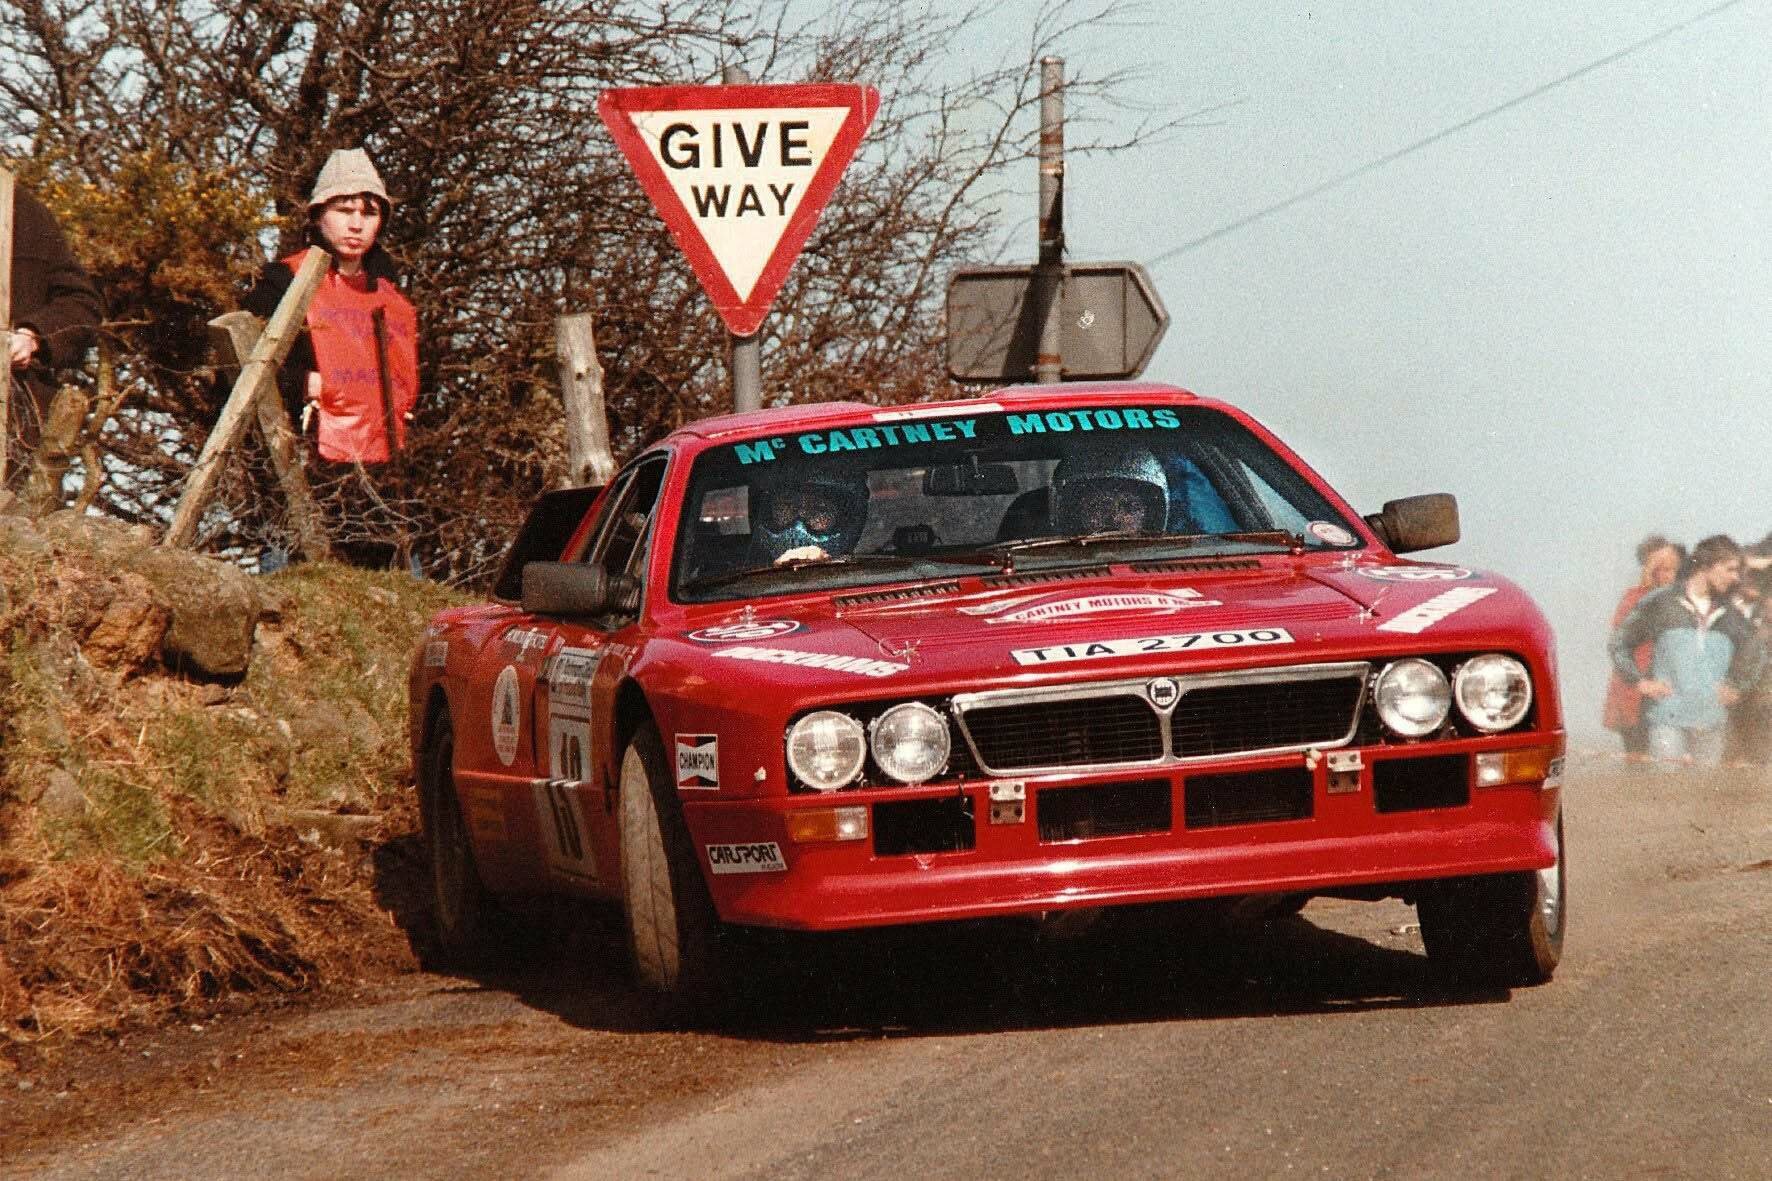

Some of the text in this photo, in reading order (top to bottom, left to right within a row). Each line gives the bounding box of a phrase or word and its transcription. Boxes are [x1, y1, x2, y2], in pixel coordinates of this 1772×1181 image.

[659, 121, 813, 169] GIVE
[690, 183, 795, 217] WAY
[798, 419, 977, 455] CARTNEY
[1006, 409, 1181, 435] MOTORS
[1022, 630, 1282, 662] TIA 2700
[680, 752, 715, 769] CHAMPION
